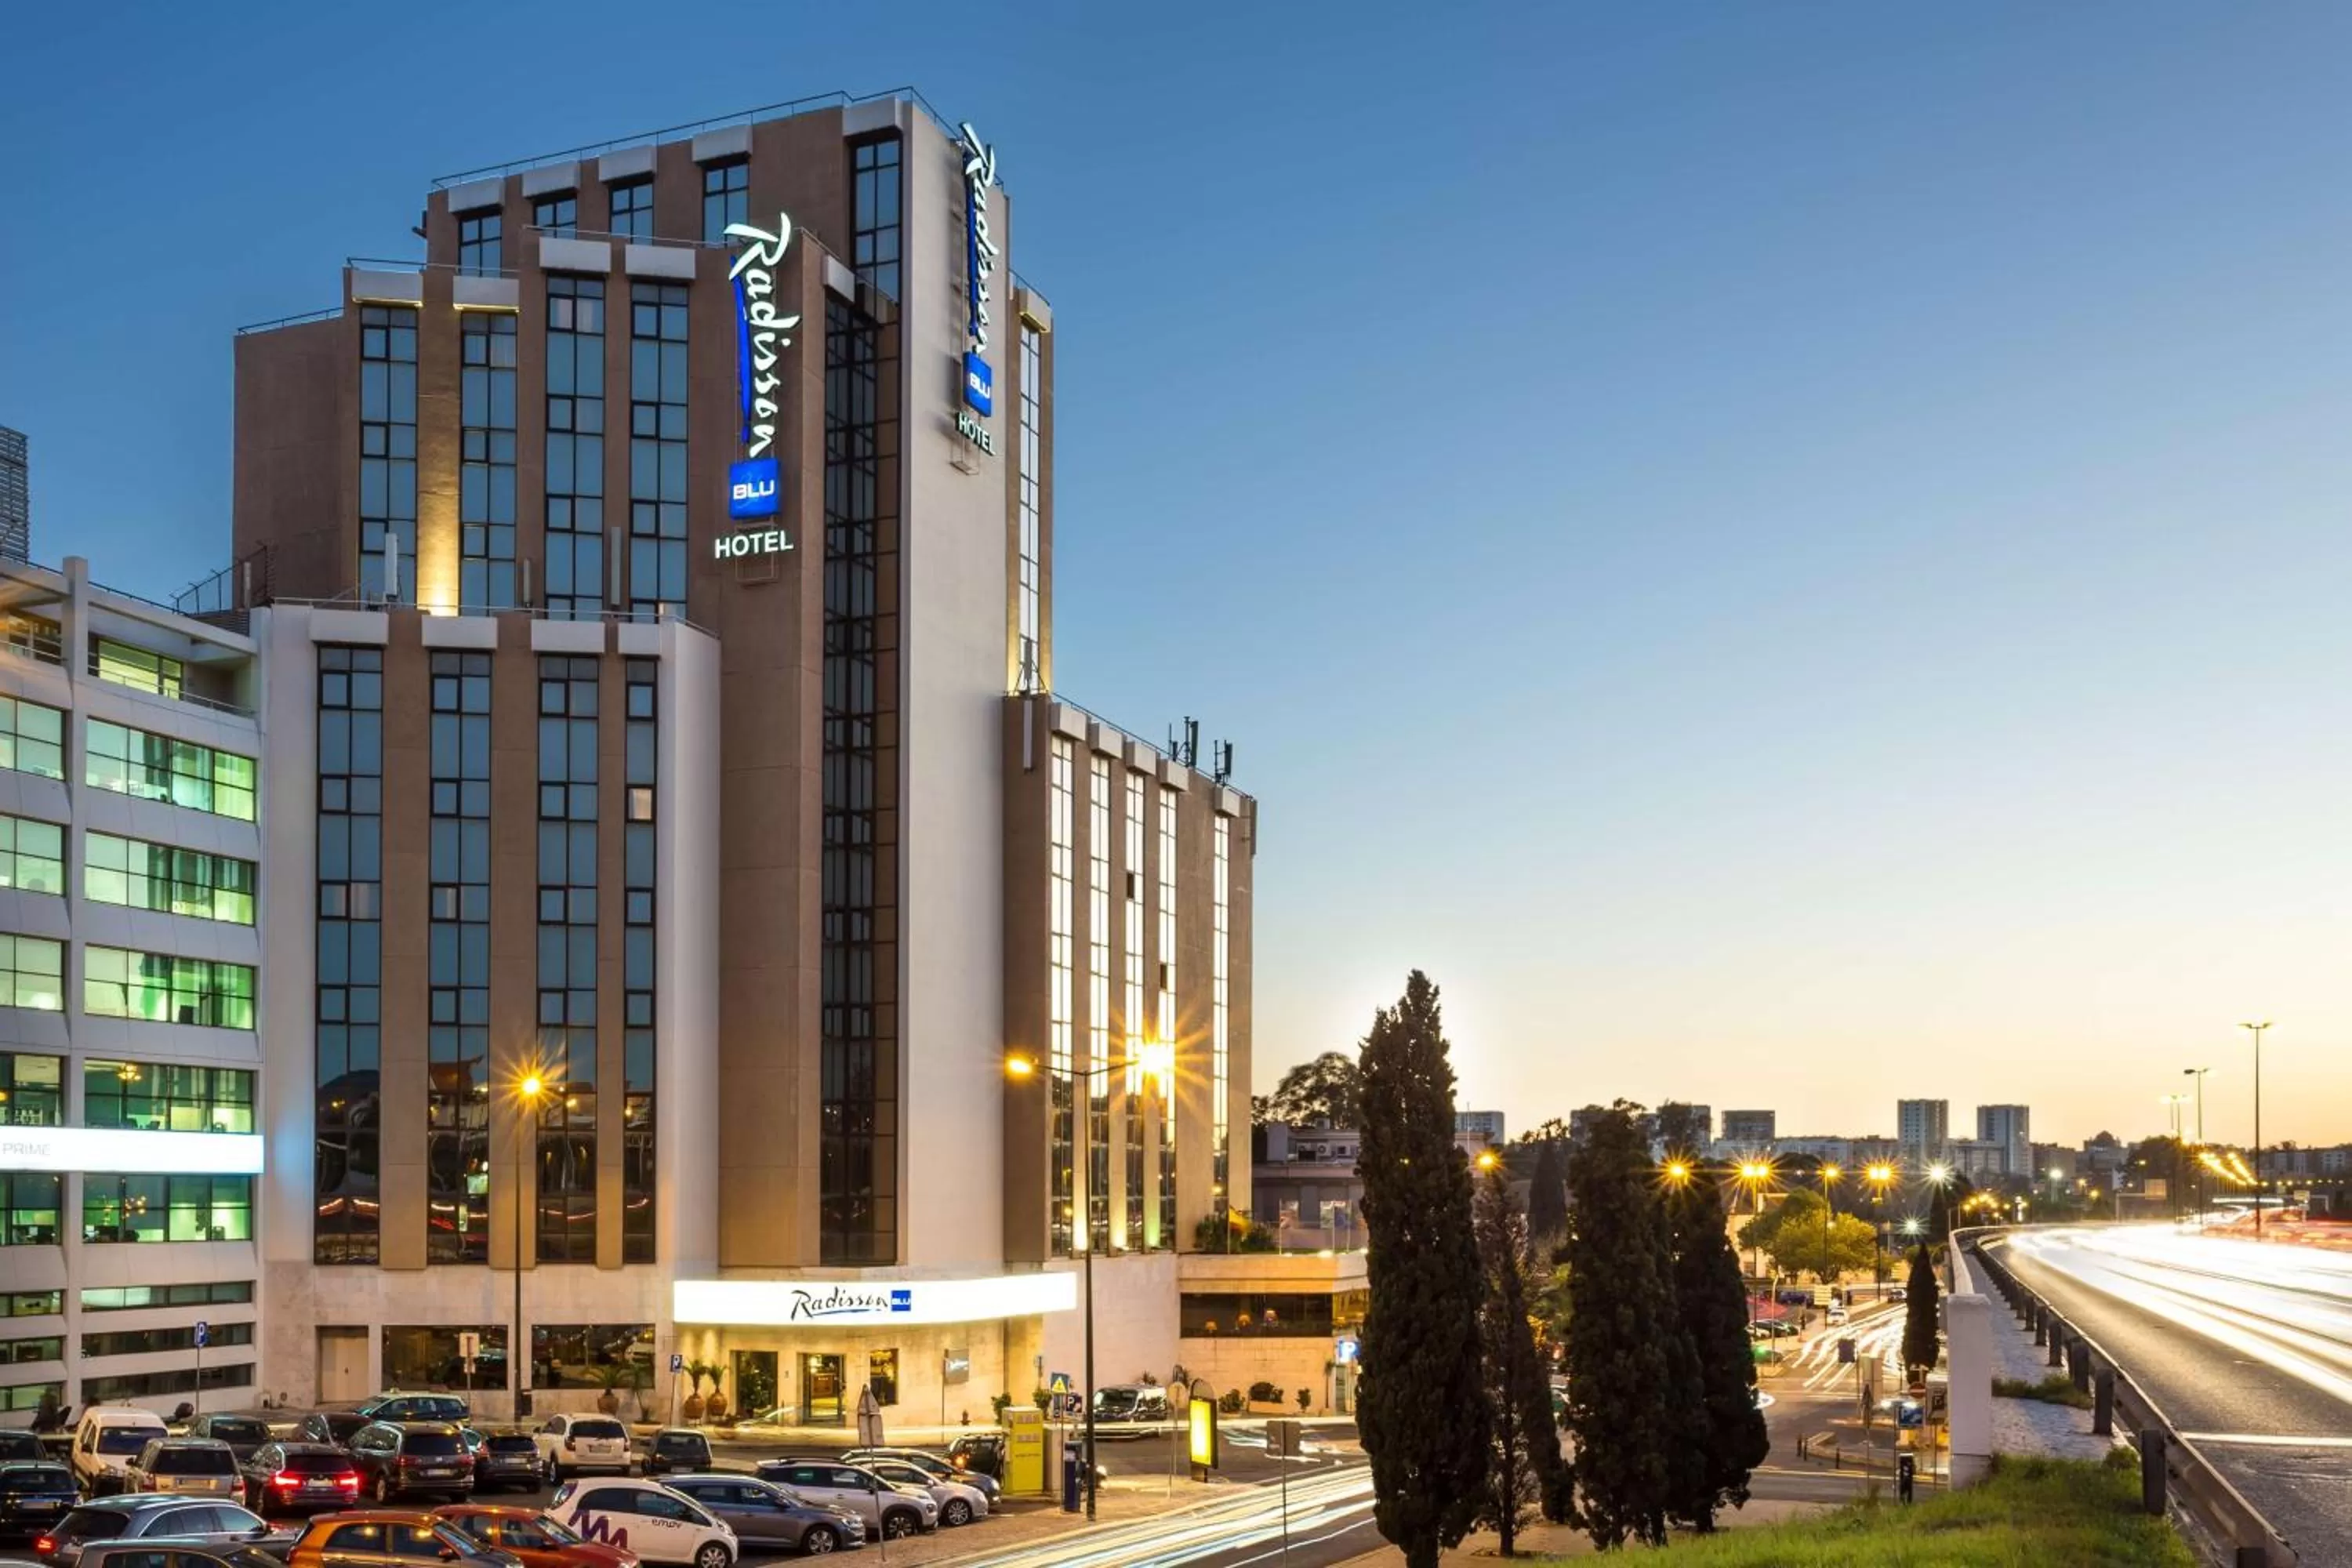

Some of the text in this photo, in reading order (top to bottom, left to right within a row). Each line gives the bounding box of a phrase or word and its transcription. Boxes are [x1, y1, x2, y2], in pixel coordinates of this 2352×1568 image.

[724, 212, 800, 458] Radisson
[969, 372, 991, 400] BLU
[958, 410, 996, 456] HOTEL
[733, 479, 775, 500] BLU
[714, 530, 794, 560] HOTEL
[2, 1142, 51, 1156] PRIME
[790, 1286, 888, 1321] Radisson
[1341, 1341, 1356, 1363] P
